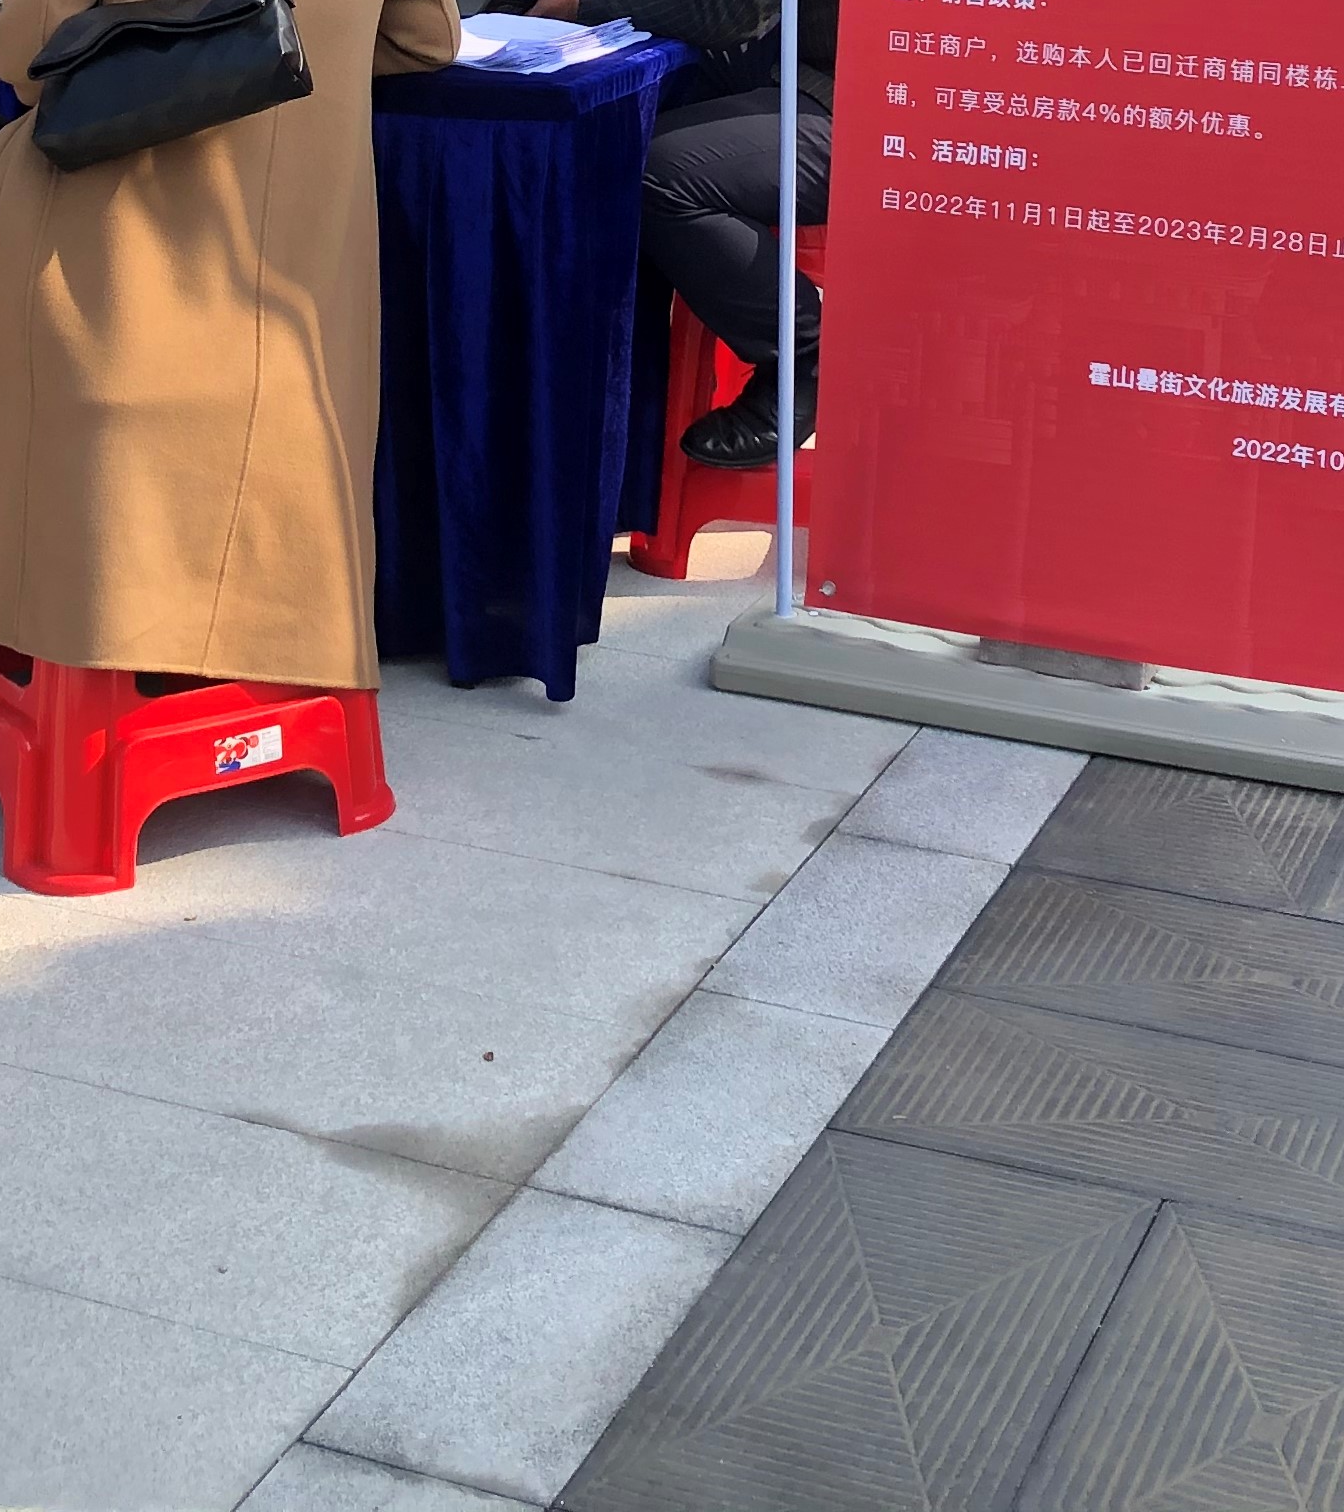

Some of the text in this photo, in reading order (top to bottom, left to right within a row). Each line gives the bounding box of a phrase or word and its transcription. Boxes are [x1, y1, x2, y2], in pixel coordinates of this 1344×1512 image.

[886, 82, 1262, 139] 铺，可享受总房款4%的额外优惠。
[884, 135, 1039, 170] 四、活动时间：
